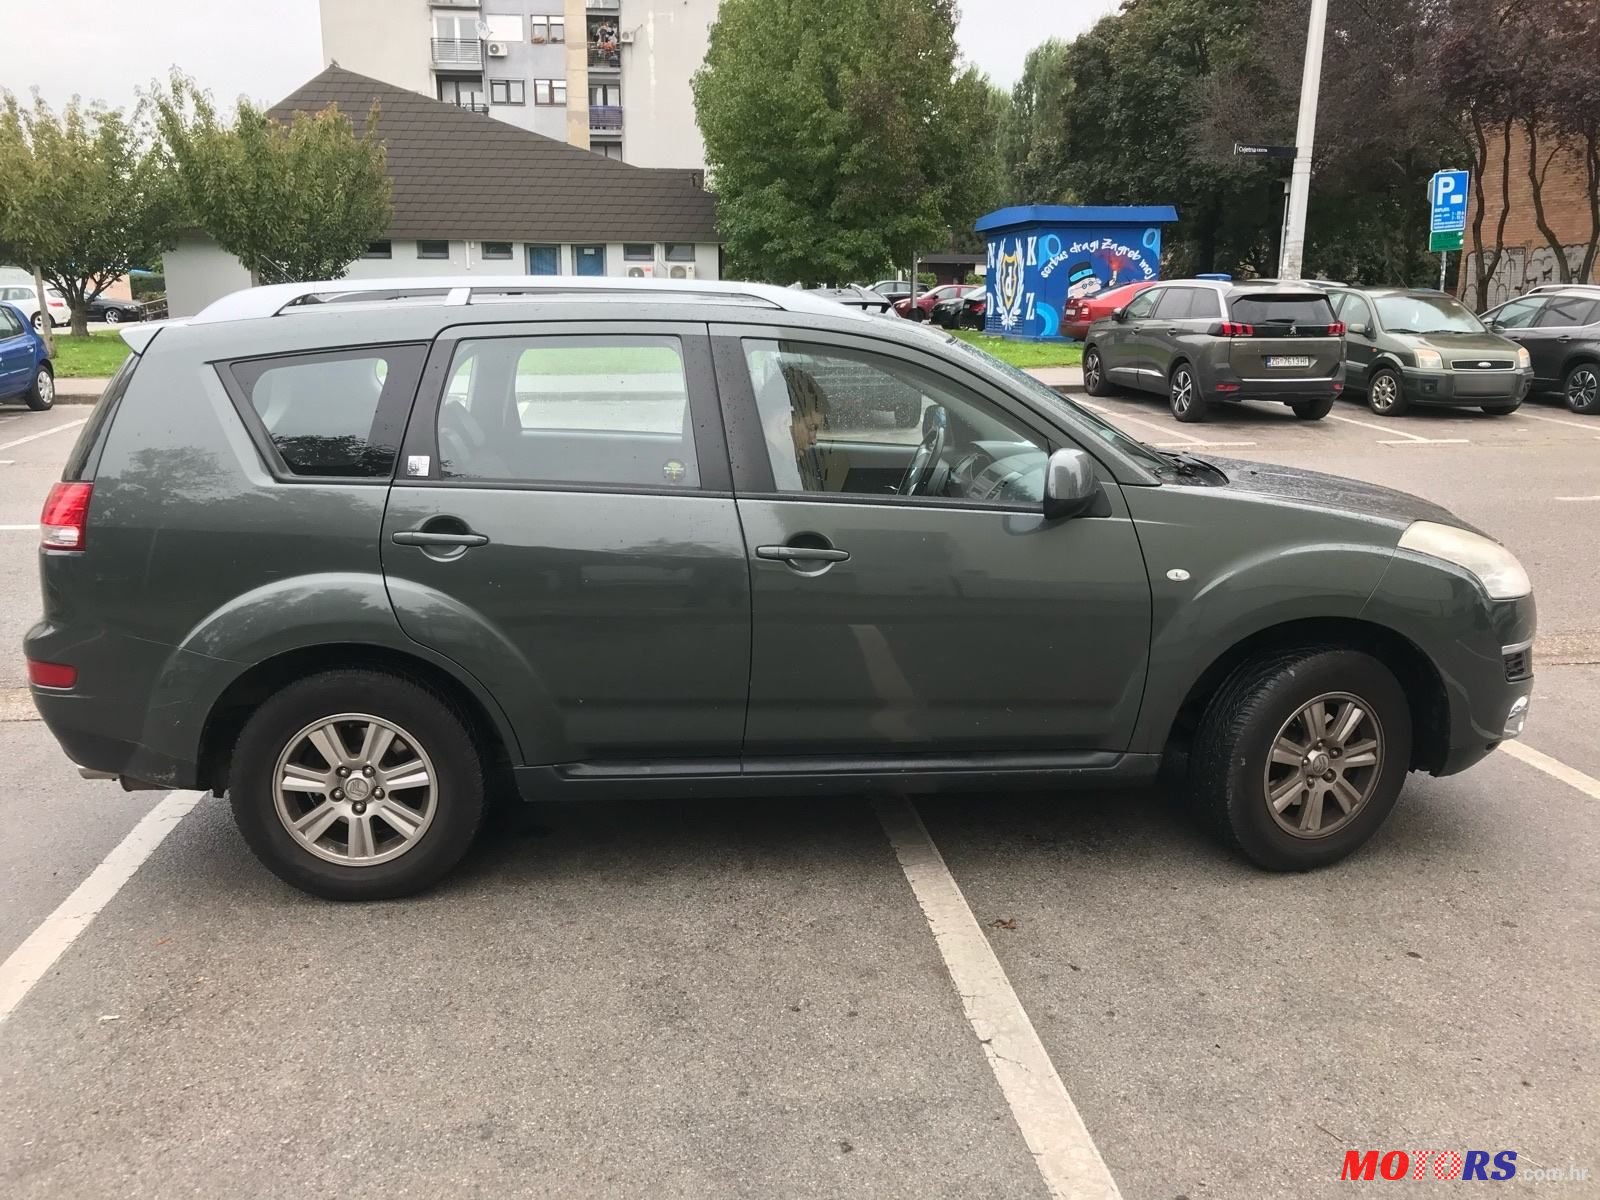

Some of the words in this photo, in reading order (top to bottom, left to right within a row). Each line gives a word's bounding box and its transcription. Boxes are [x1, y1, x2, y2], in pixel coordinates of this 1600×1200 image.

[1437, 177, 1455, 205] P
[1070, 240, 1098, 253] dragi
[1101, 238, 1141, 261] Zagreb
[1139, 259, 1156, 280] moj
